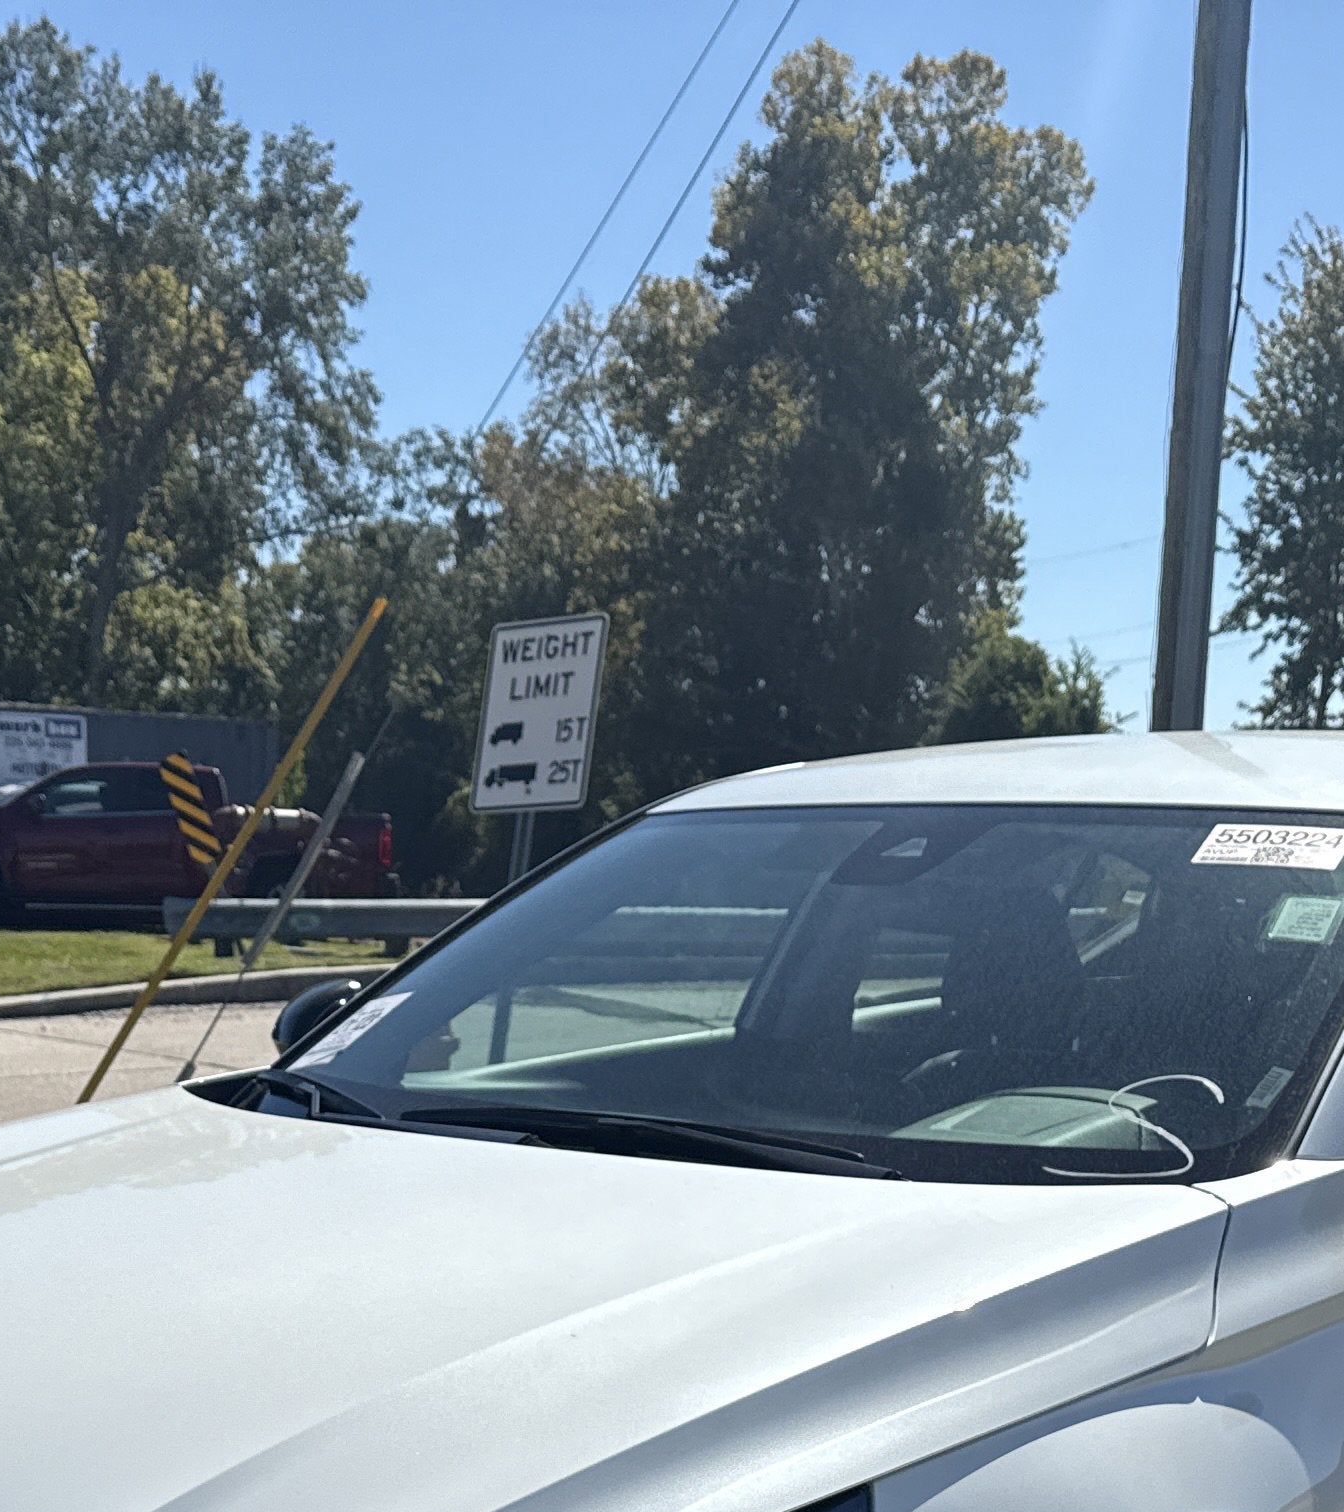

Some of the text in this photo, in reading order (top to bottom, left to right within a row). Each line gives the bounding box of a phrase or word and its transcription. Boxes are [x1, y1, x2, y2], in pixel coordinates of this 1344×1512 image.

[502, 631, 595, 664] WEIGHT
[509, 671, 577, 701] LIMIT
[555, 716, 588, 744] 15T
[547, 759, 583, 785] 25T
[1215, 829, 1344, 849] 5503224
